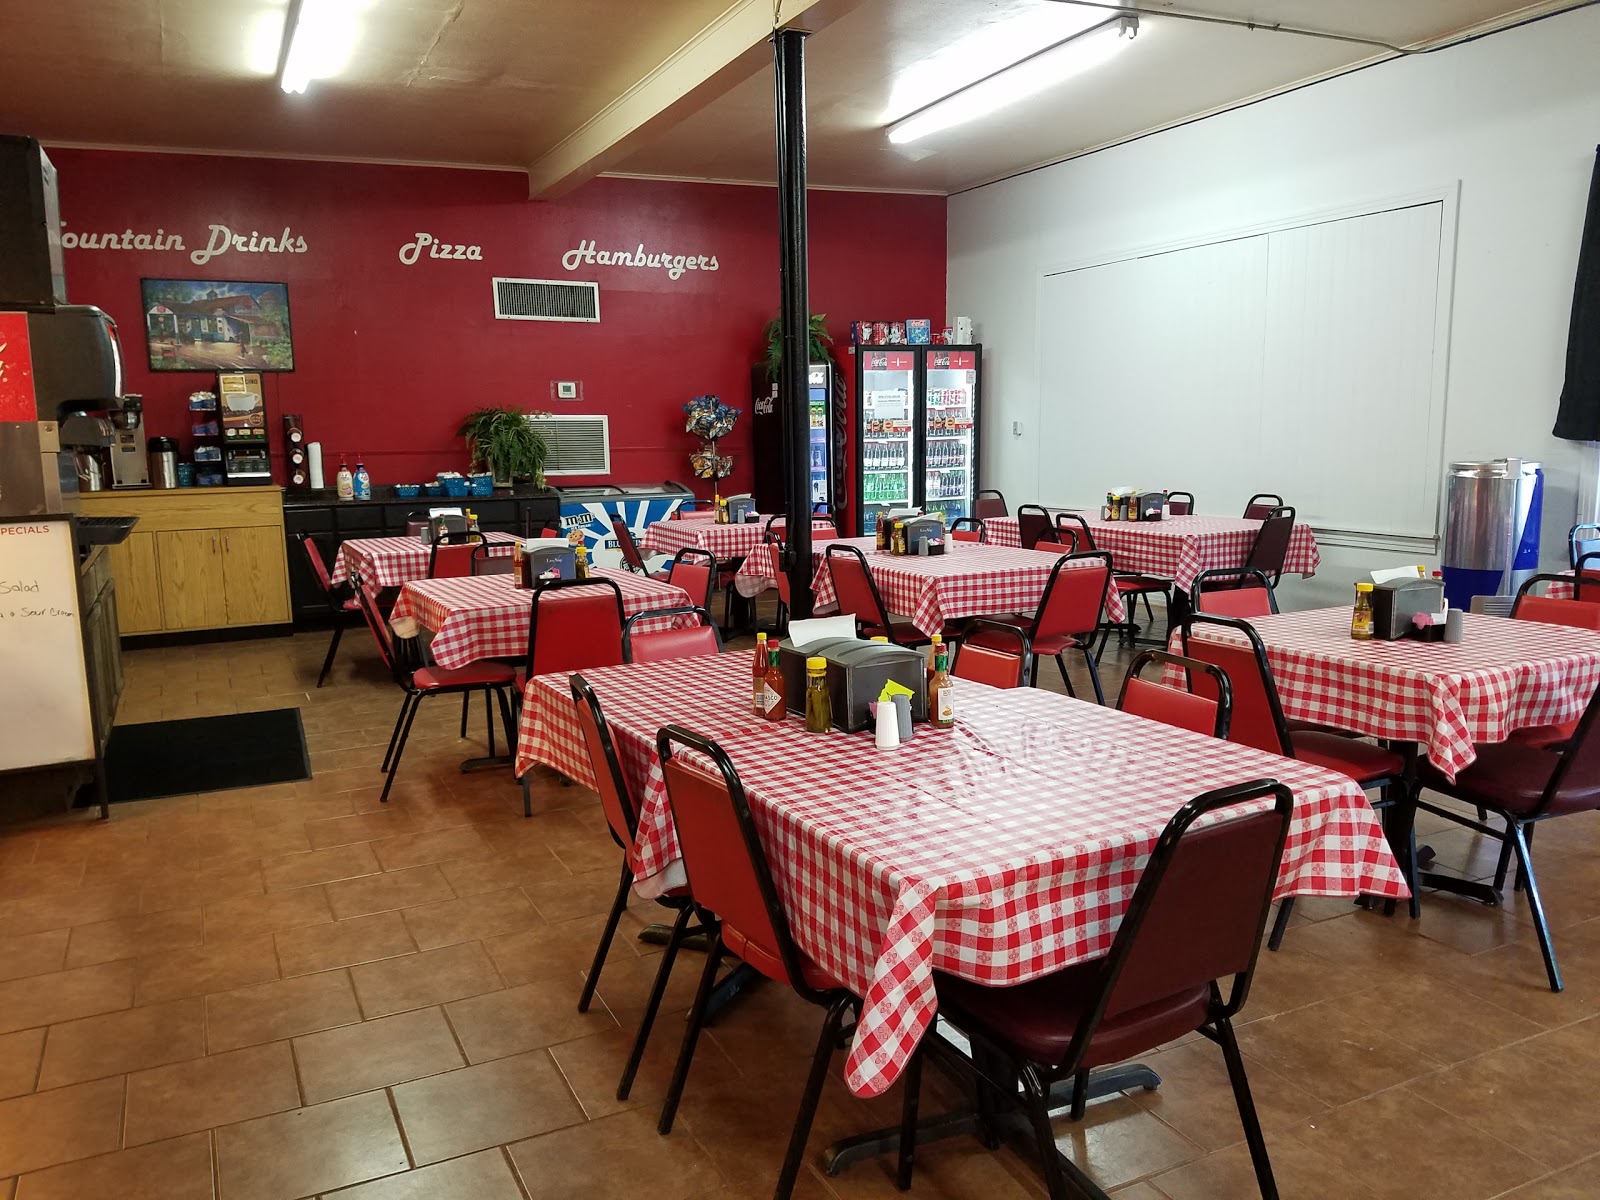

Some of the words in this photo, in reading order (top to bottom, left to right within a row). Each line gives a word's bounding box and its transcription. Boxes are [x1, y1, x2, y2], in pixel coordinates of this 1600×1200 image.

[60, 221, 185, 250] ountain
[190, 224, 308, 265] Drinks
[399, 232, 483, 265] Pizza
[561, 239, 719, 280] Hamburgers
[0, 525, 49, 535] PECIALS
[608, 540, 621, 548] BLU
[0, 580, 40, 594] Salad
